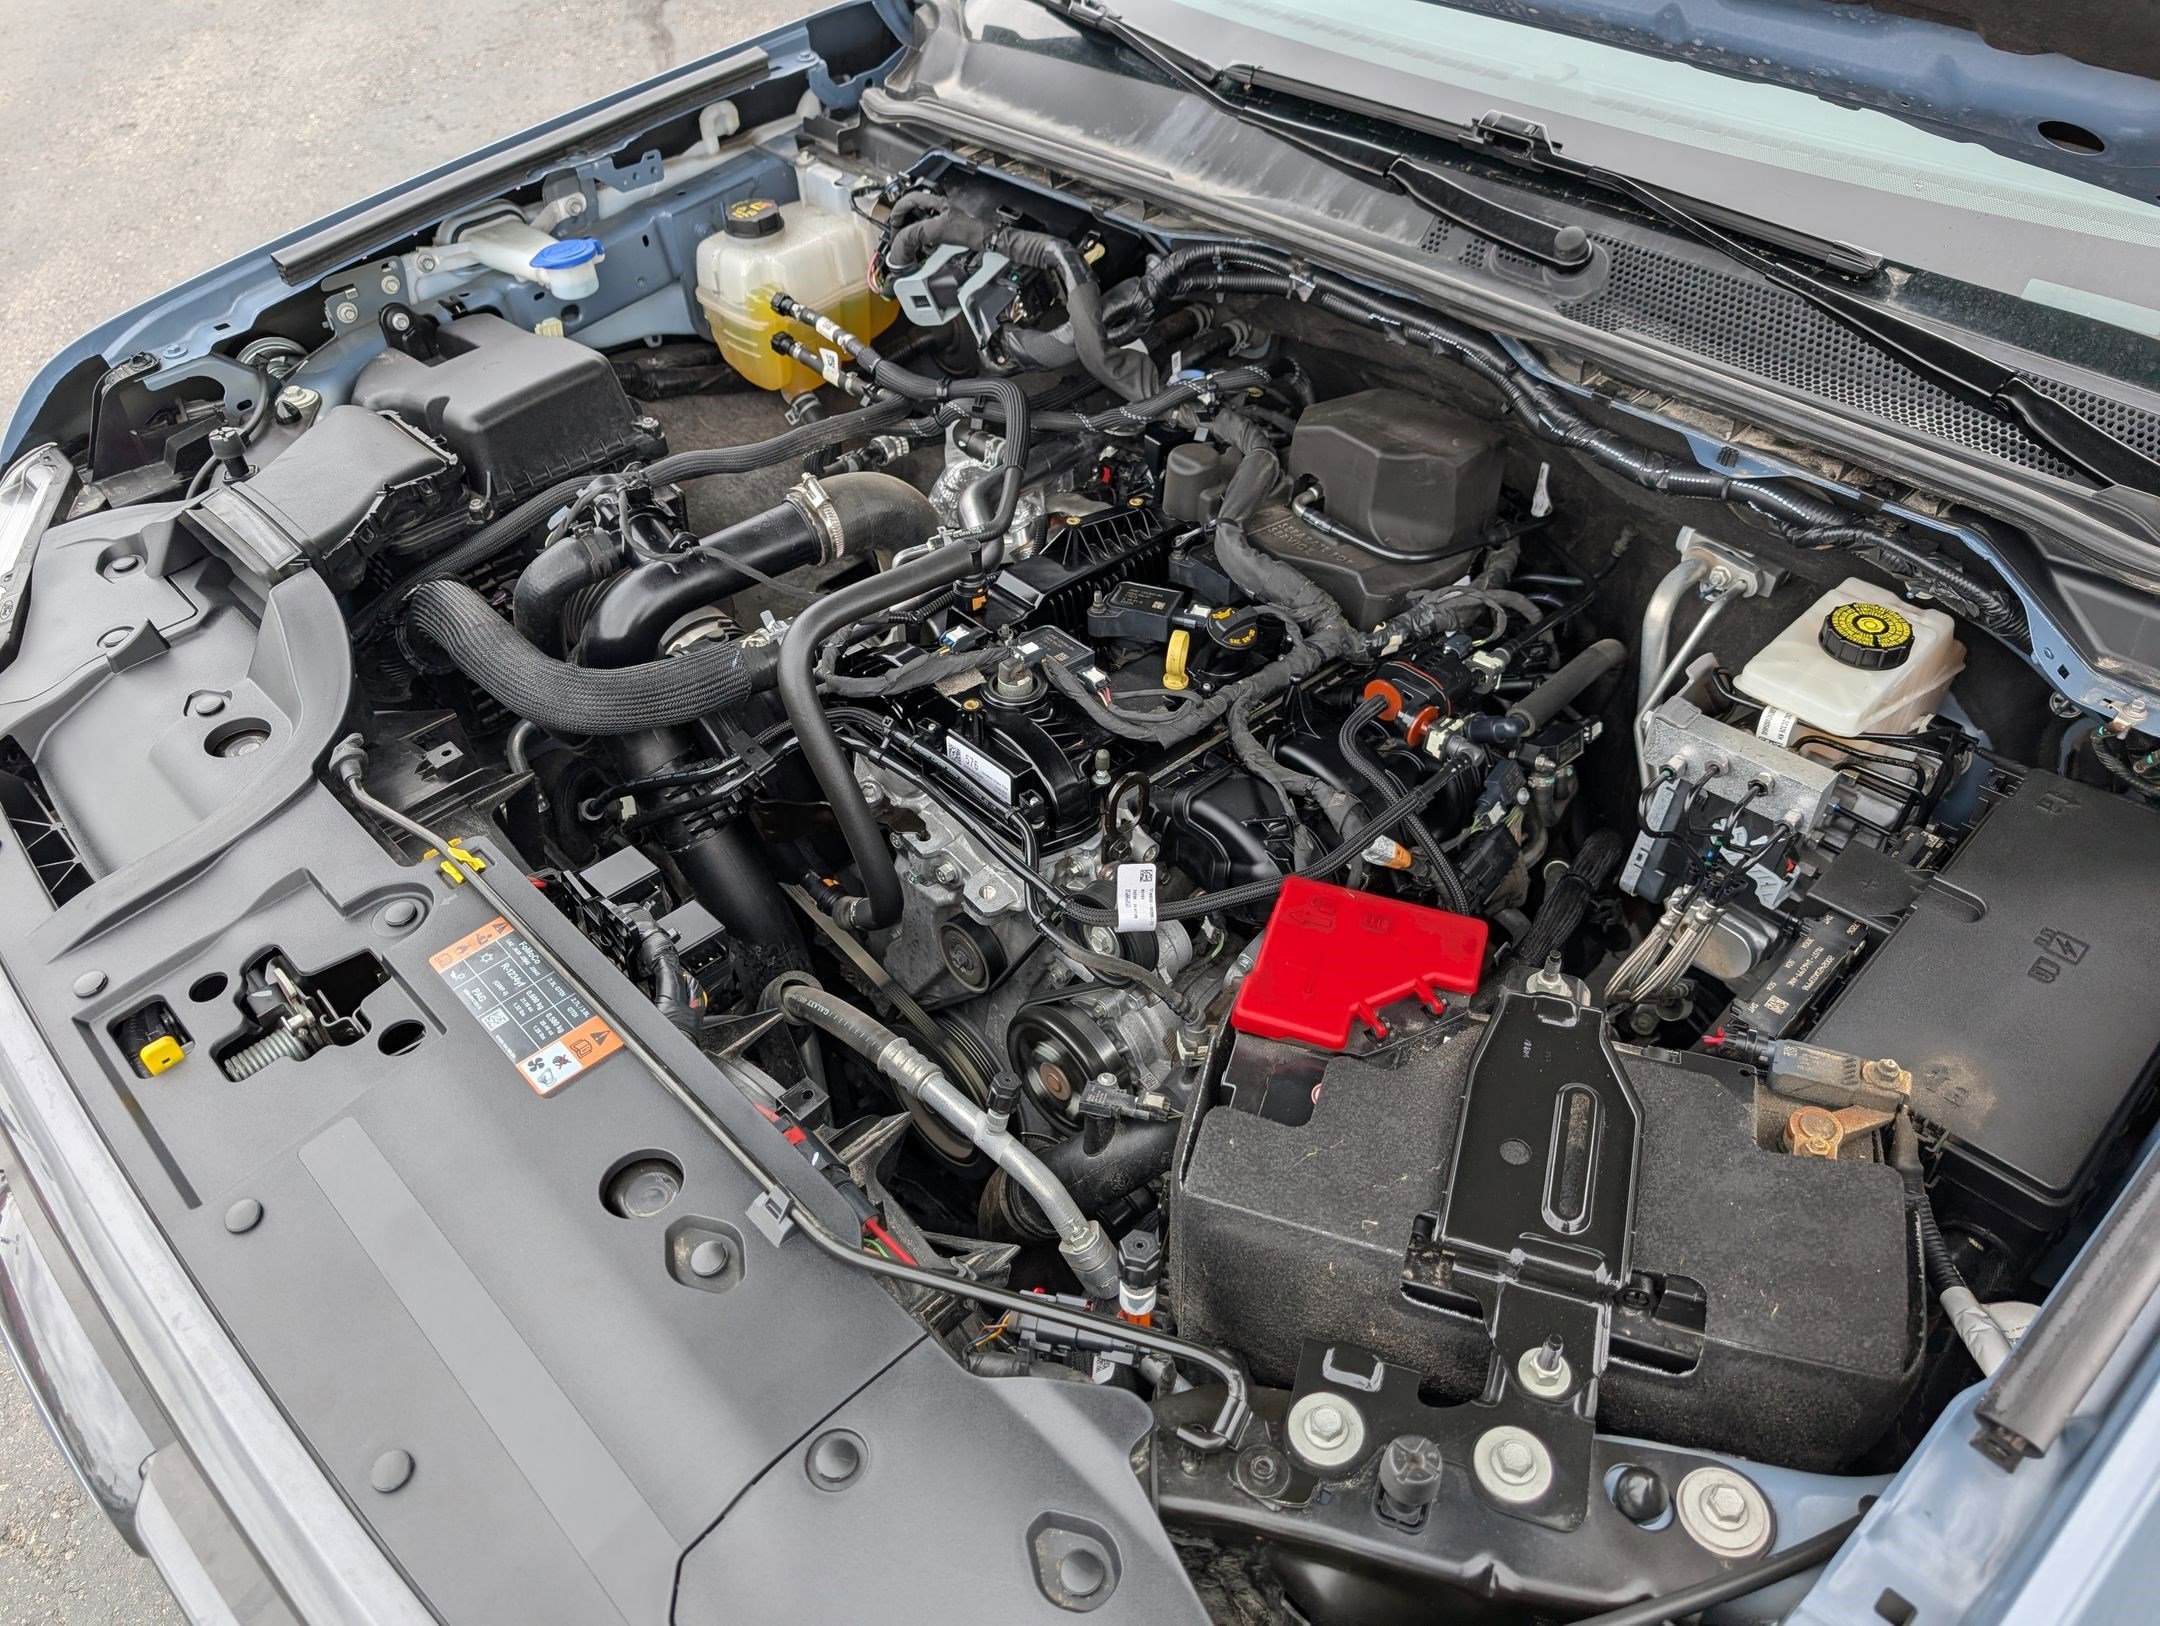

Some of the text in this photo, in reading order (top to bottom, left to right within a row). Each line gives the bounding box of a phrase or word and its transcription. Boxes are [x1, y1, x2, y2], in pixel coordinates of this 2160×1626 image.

[965, 754, 979, 771] 576
[1801, 936, 1814, 949] 300A
[519, 941, 541, 964] FoMoCo
[500, 962, 526, 988] R-1234yf
[471, 986, 487, 1003] PAG
[525, 989, 544, 1011] 0.600 kg
[806, 1000, 829, 1015] GALAXY
[545, 1011, 565, 1034] 0.580 kg
